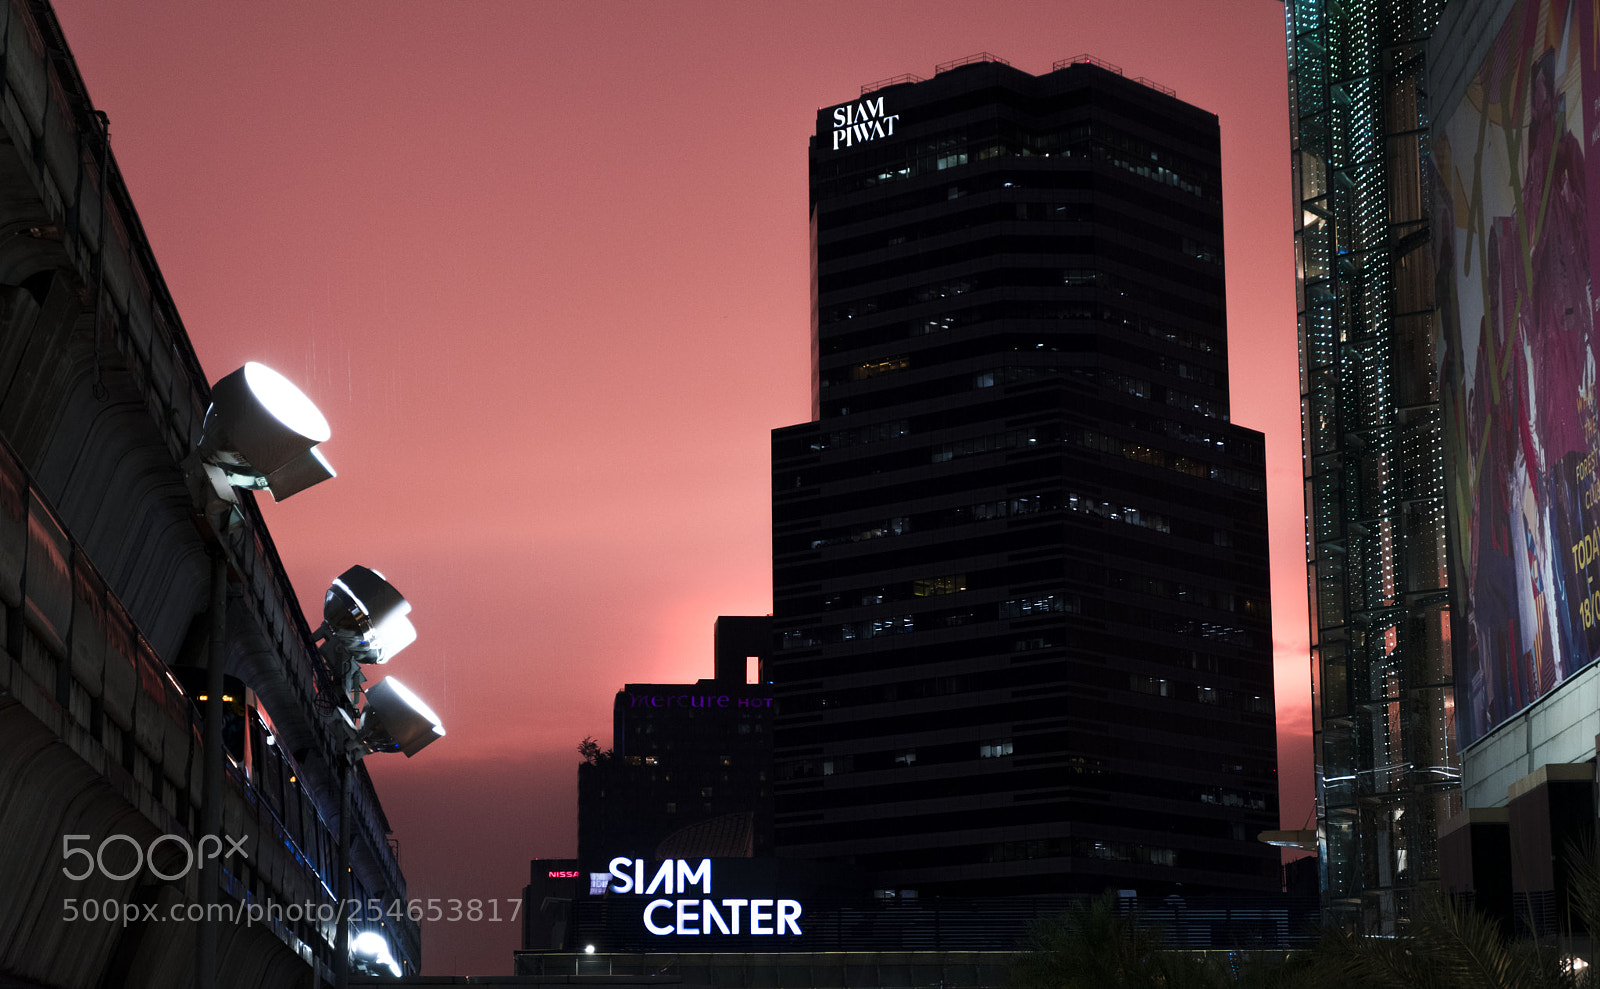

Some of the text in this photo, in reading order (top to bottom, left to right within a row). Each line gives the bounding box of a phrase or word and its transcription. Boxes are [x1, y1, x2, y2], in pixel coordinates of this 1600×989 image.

[833, 97, 884, 128] SIAM
[833, 114, 899, 150] PIWAT
[609, 857, 711, 895] SIAM
[643, 899, 802, 935] CENTER
